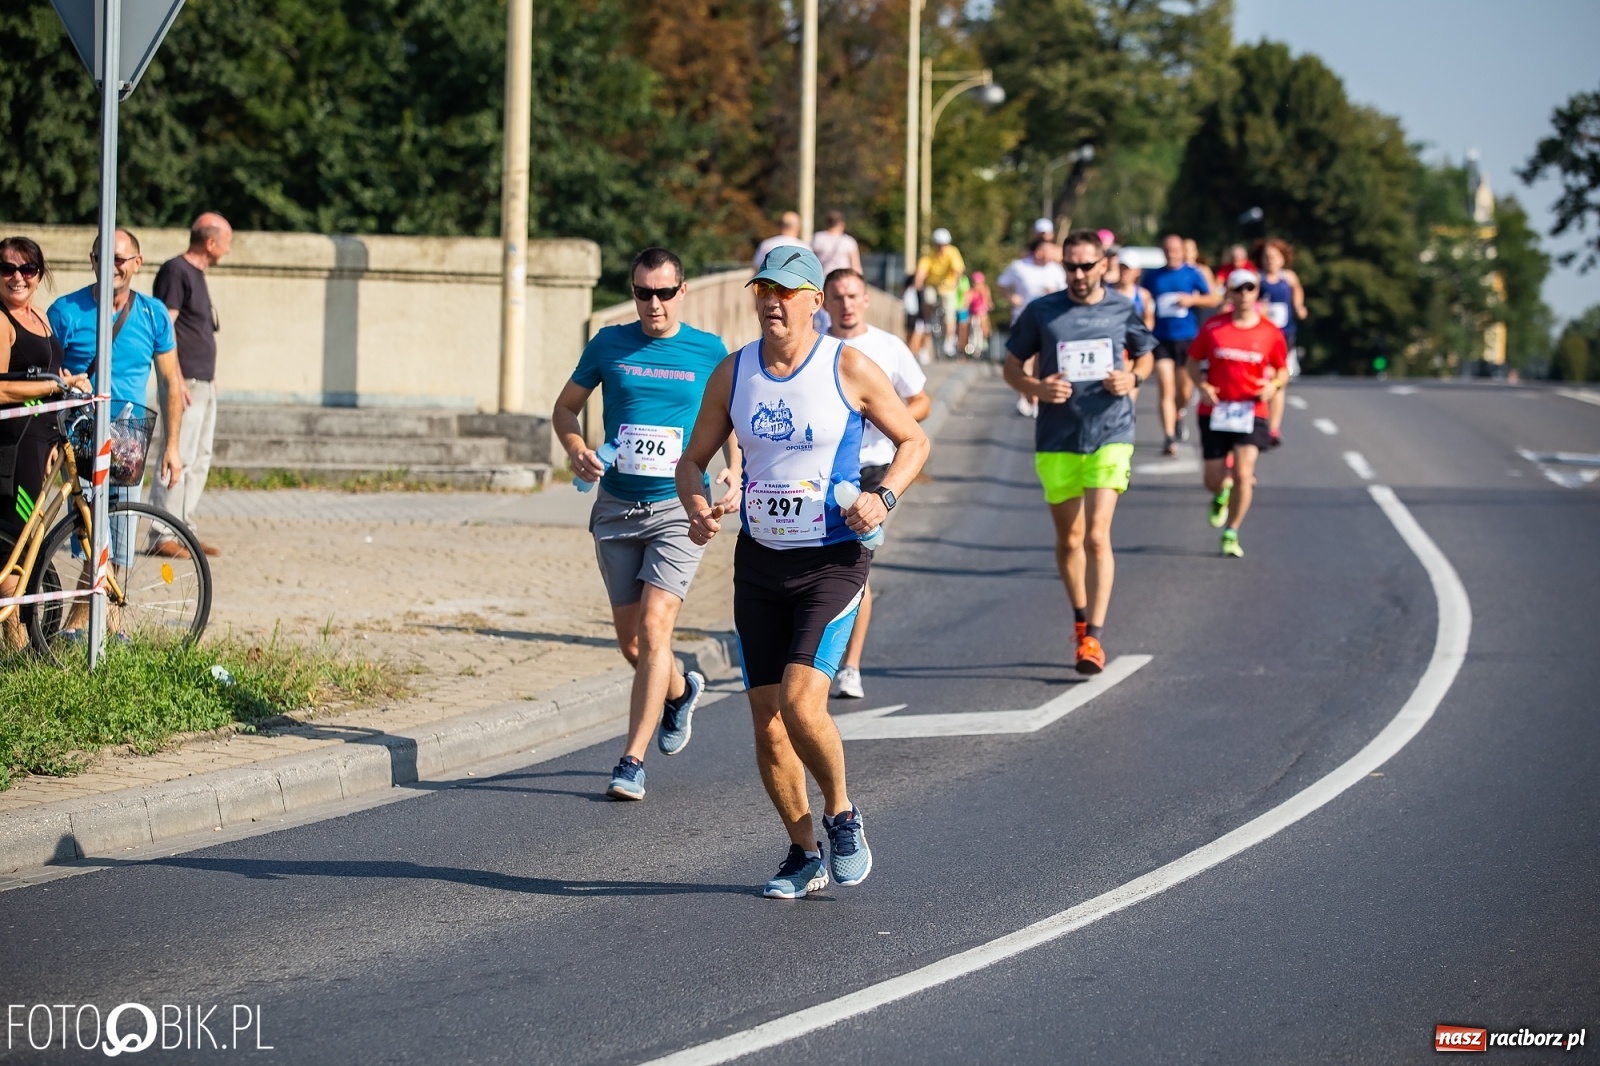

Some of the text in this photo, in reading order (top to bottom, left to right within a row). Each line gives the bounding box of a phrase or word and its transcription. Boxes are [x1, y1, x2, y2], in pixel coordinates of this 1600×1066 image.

[1080, 352, 1095, 364] 78
[623, 365, 695, 382] TRAINING
[634, 439, 666, 456] 296
[767, 497, 804, 517] 297
